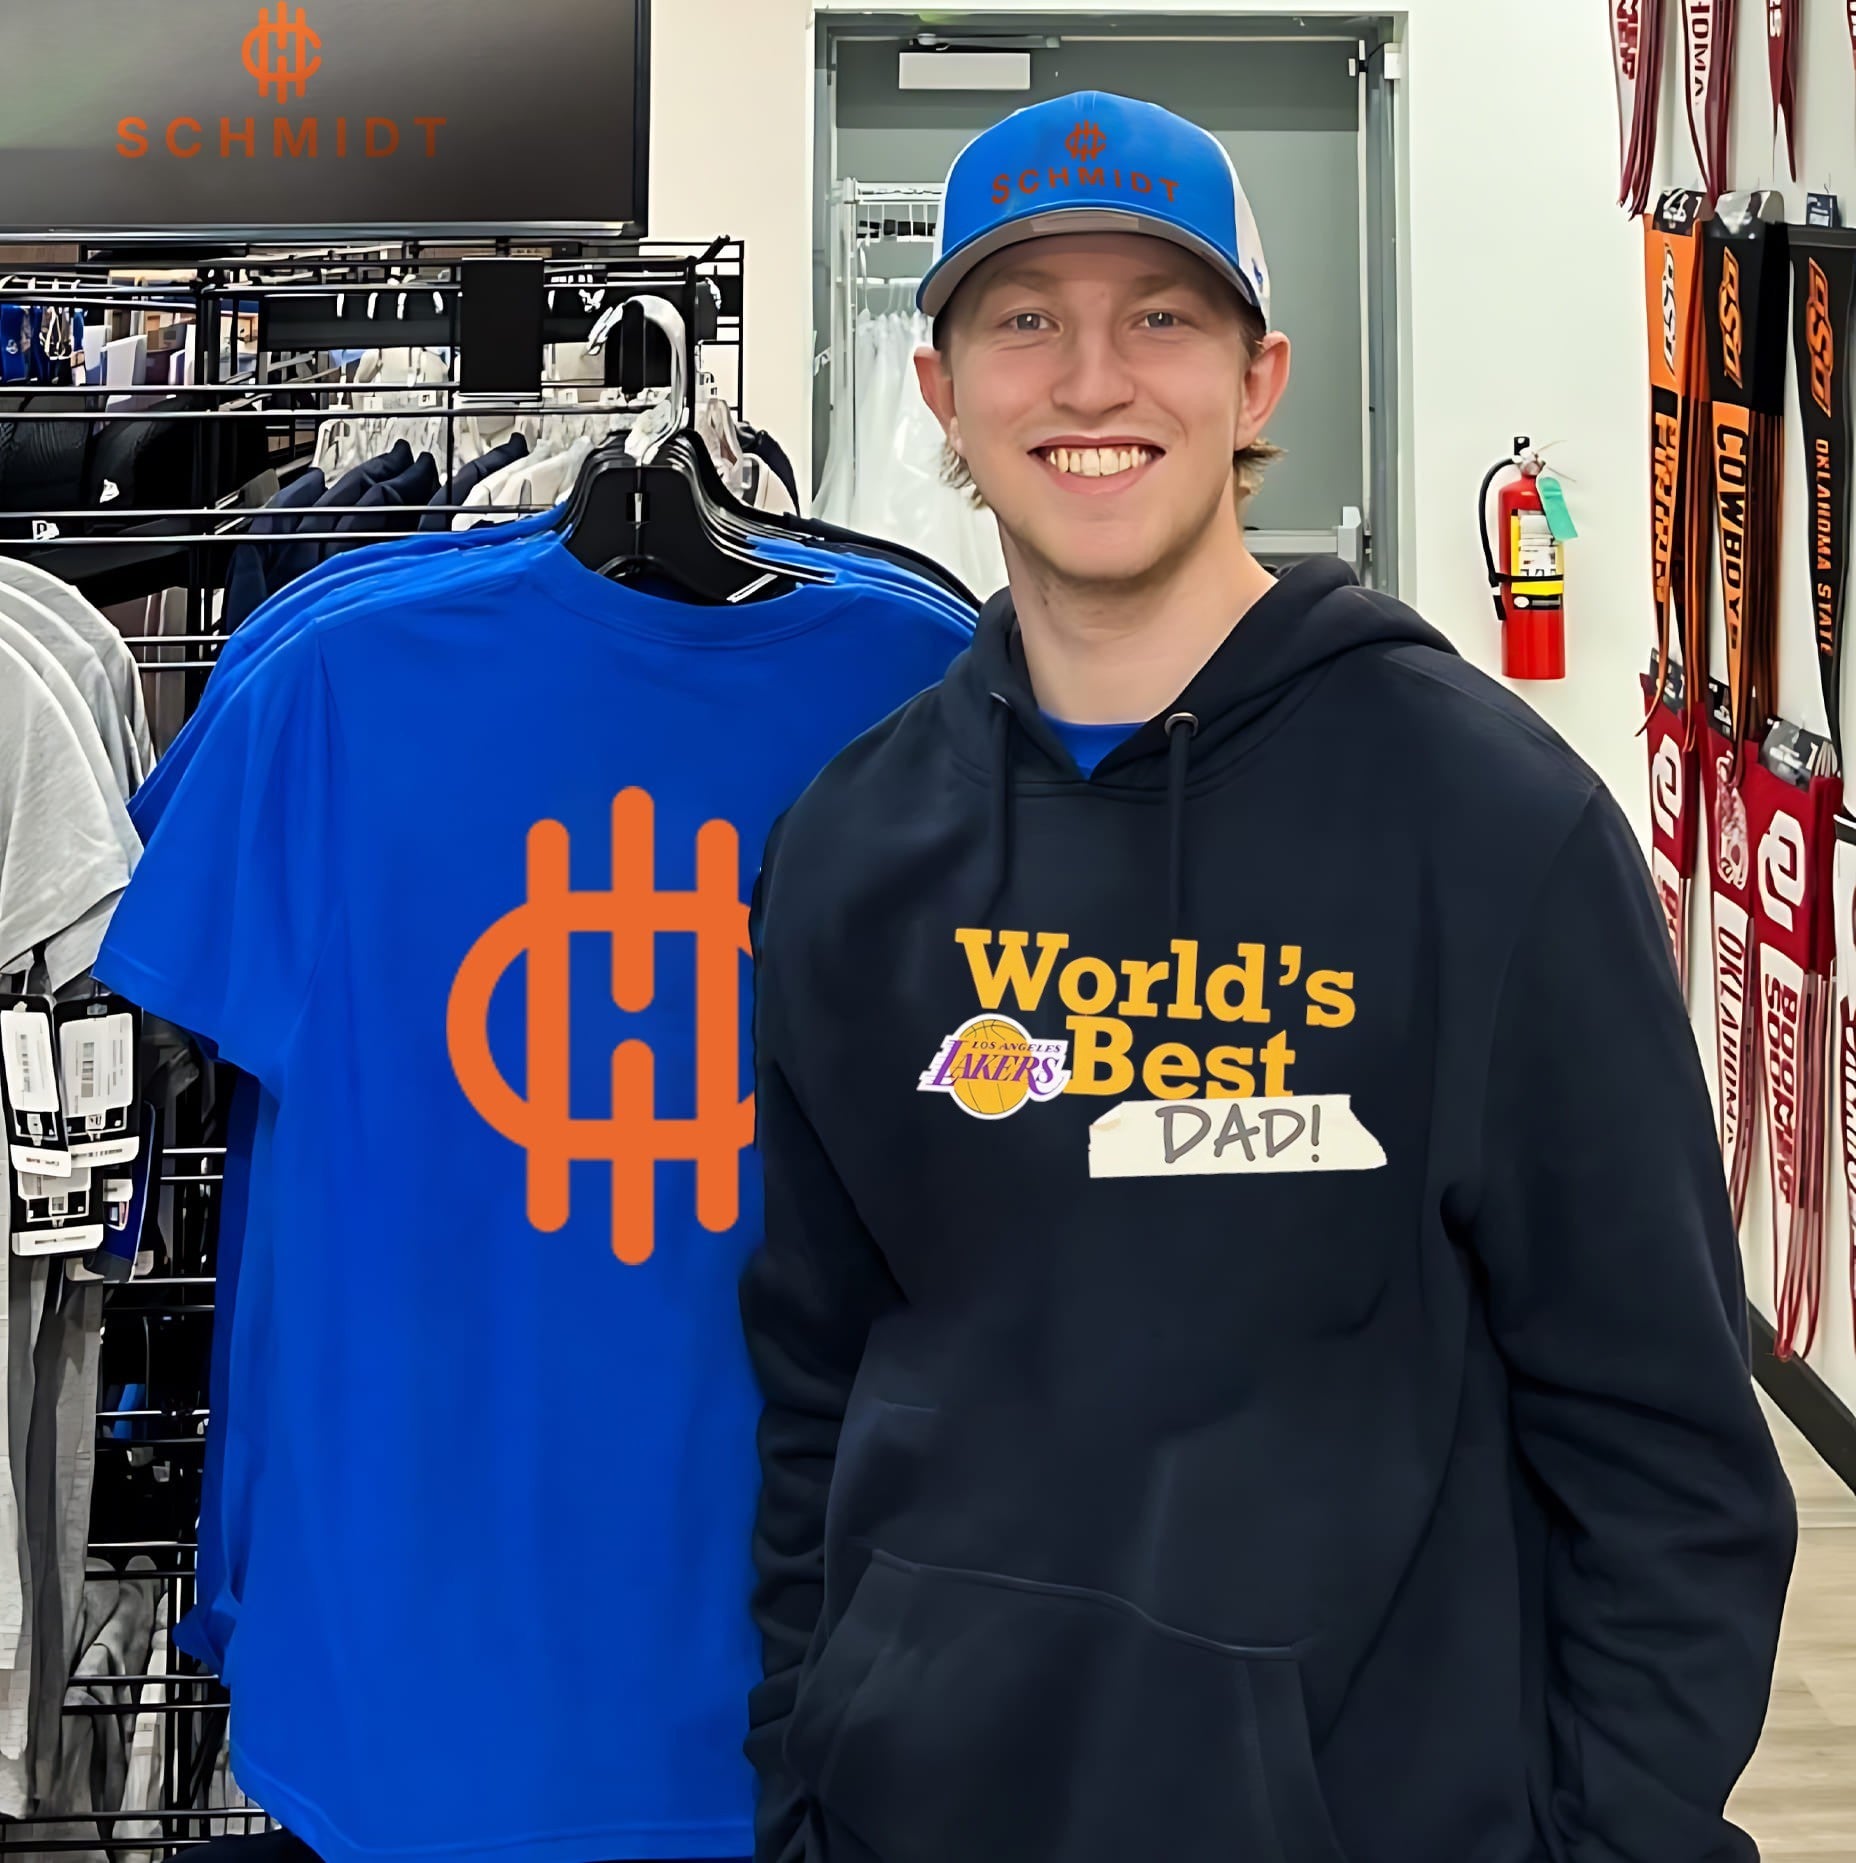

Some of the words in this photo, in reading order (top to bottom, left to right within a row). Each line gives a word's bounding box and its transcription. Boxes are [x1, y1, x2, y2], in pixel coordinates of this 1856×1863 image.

[115, 116, 448, 158] SCHMIDT
[991, 167, 1179, 205] SCHMIDT
[1815, 438, 1832, 570] OKLAHOMA
[1817, 582, 1834, 657] STATE
[954, 927, 1356, 1028] World's
[926, 1039, 1064, 1096] LAKERS
[972, 1041, 996, 1049] LOS
[1000, 1042, 1062, 1054] ANGELES
[1063, 1015, 1296, 1100] Best
[1718, 925, 1744, 1144] OKLAHOMA
[1155, 1102, 1321, 1164] DAD!
